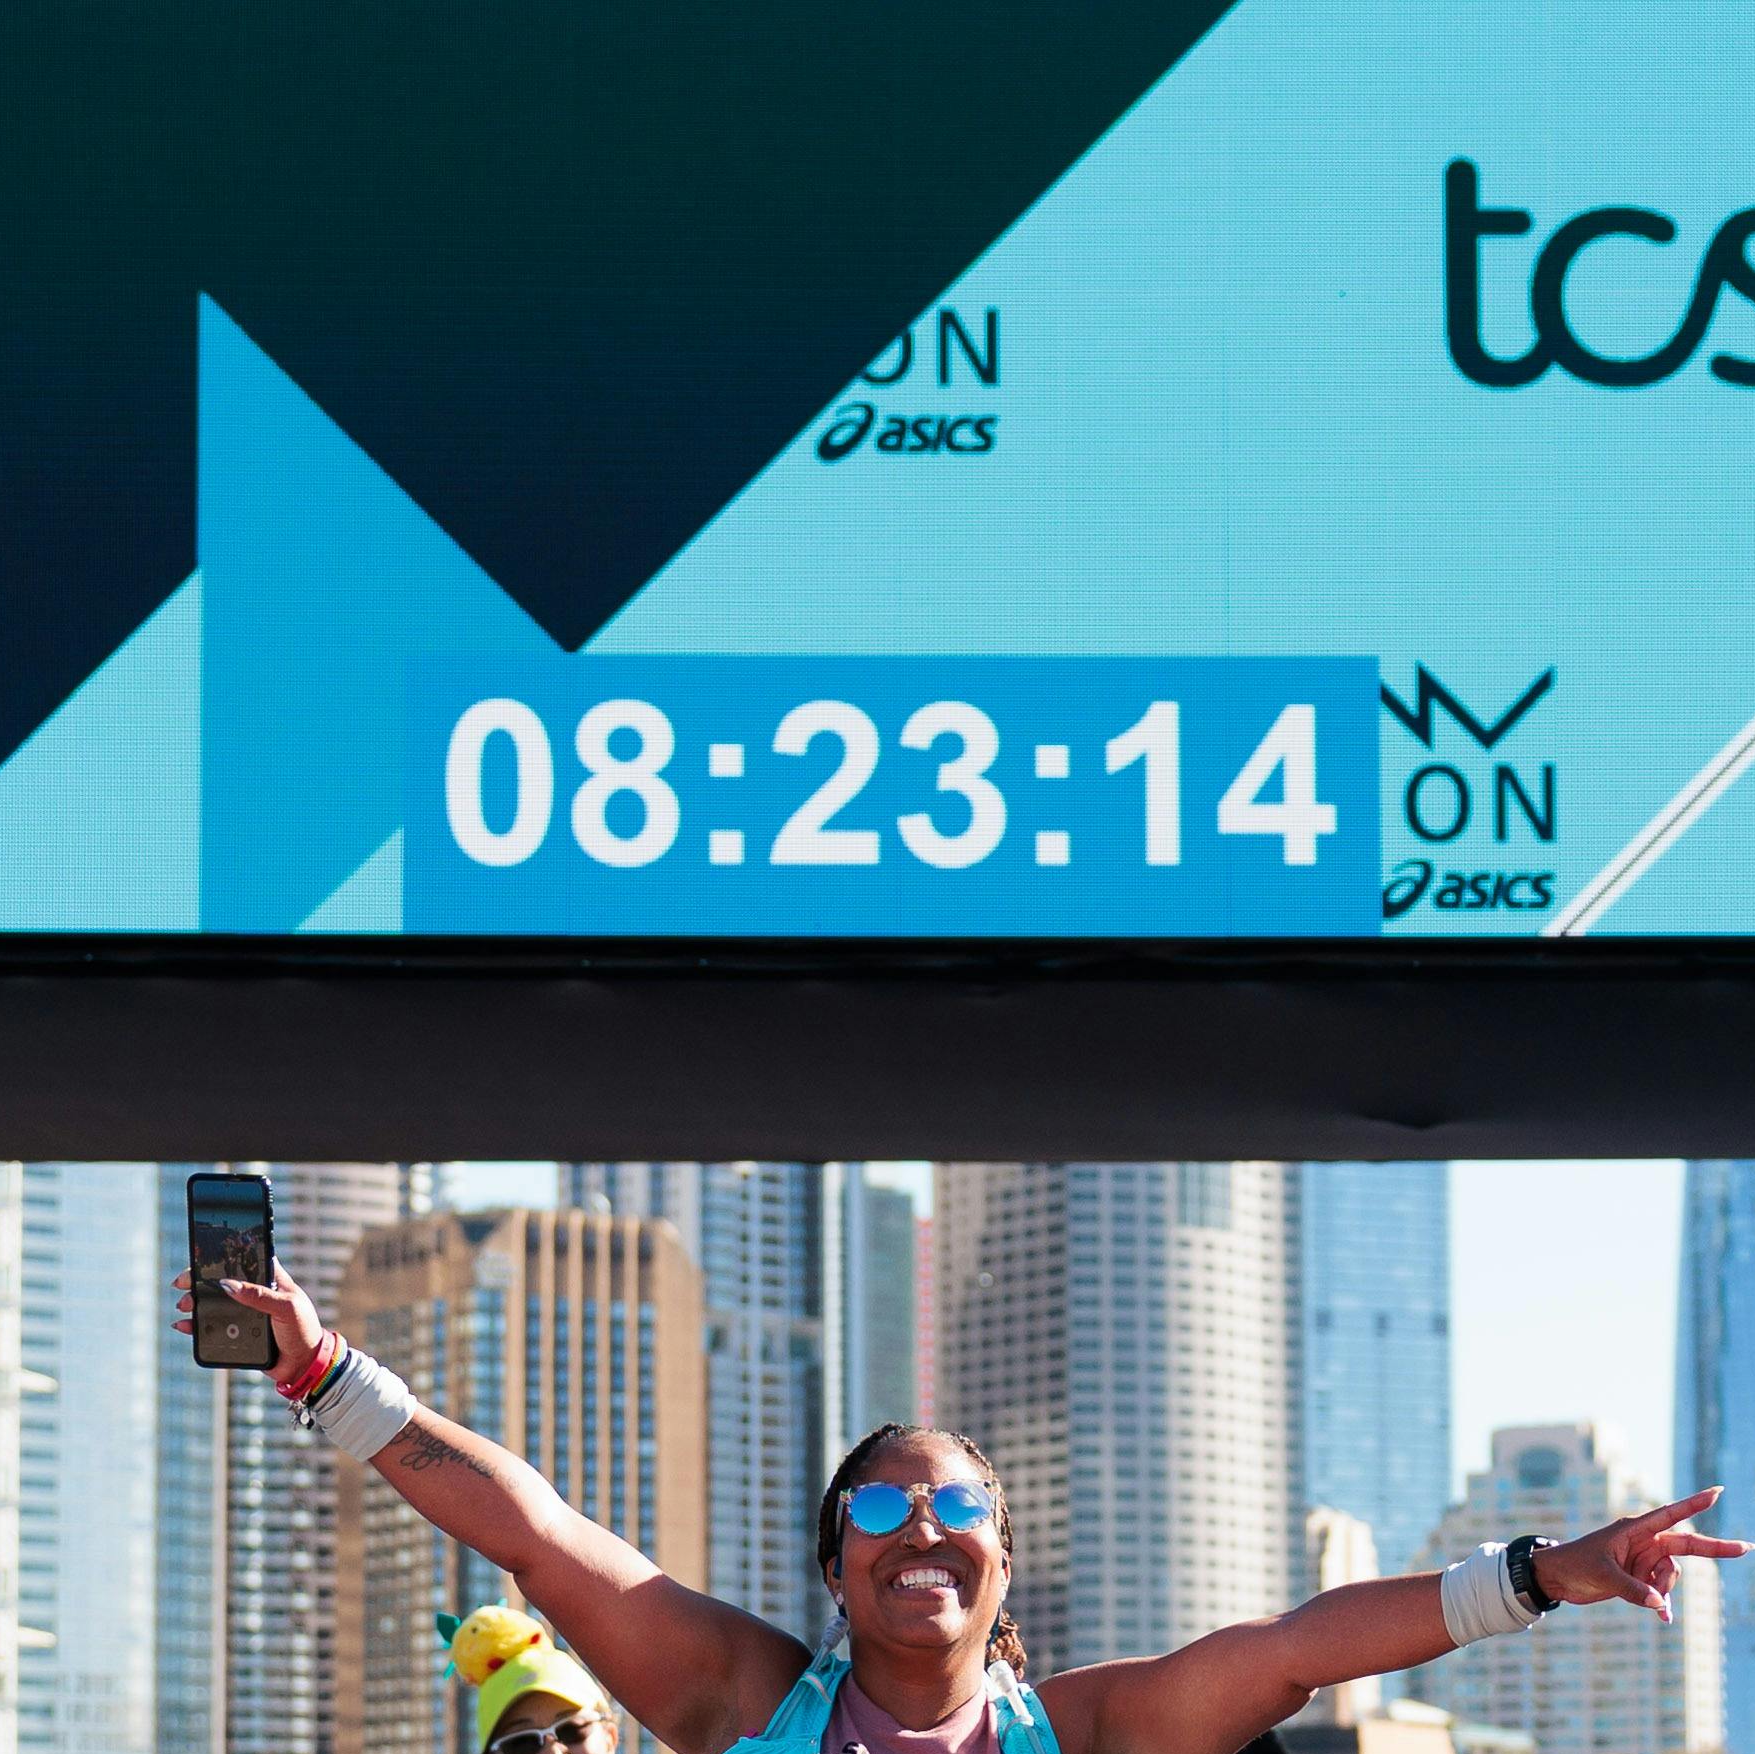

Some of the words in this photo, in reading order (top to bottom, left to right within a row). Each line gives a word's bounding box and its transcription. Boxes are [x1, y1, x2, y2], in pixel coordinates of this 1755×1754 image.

[876, 417, 998, 454] asics
[445, 699, 1338, 868] 08:23:14
[1404, 764, 1557, 844] ON
[1433, 873, 1555, 910] asics
